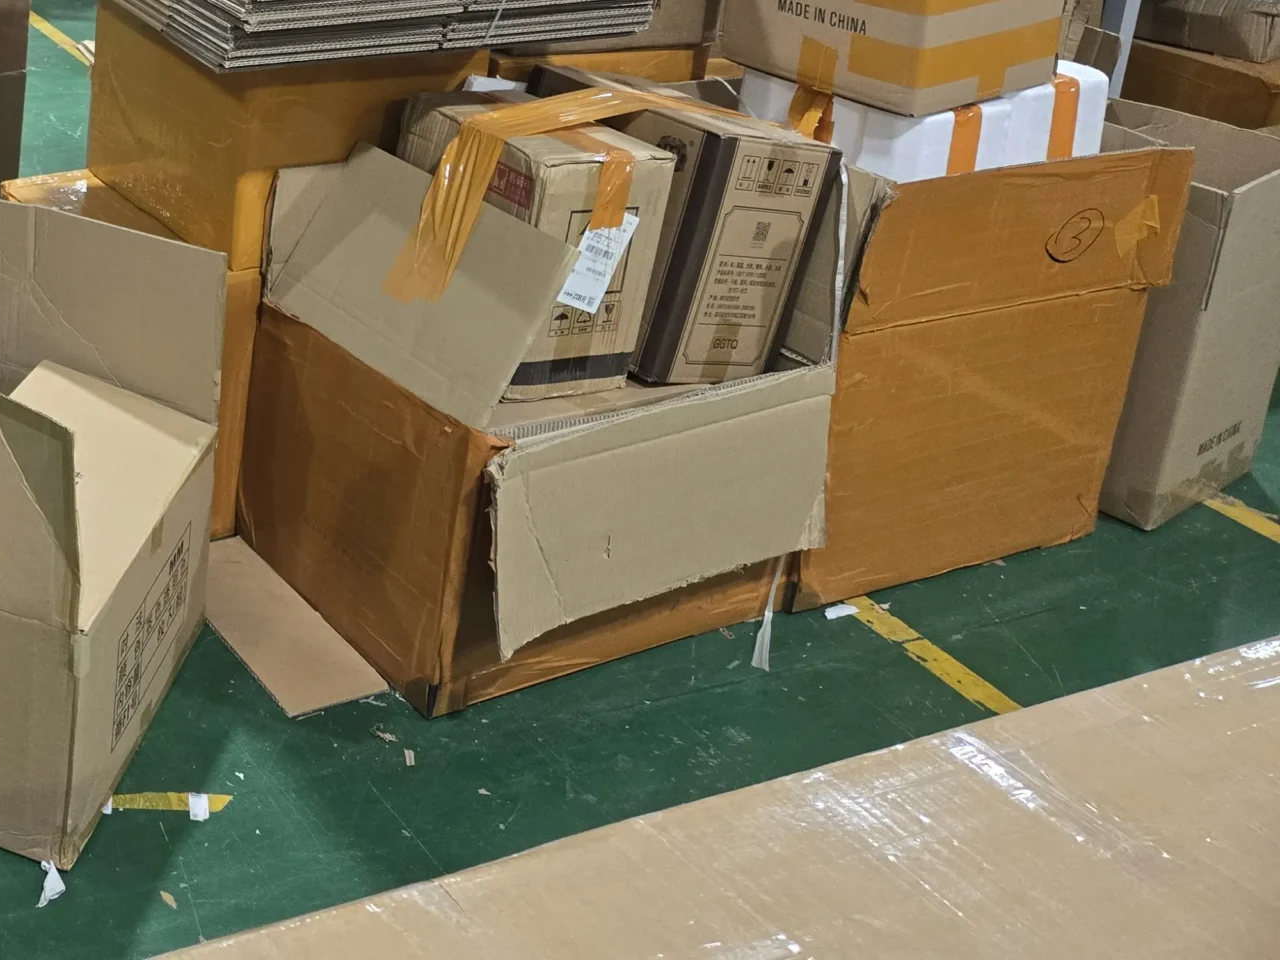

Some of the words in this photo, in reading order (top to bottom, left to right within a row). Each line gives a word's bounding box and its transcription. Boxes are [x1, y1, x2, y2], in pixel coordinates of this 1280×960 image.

[813, 7, 826, 24] IN
[829, 11, 867, 35] CHINA
[713, 338, 738, 350] GGTQ
[1197, 435, 1217, 457] MADE
[1222, 420, 1243, 442] CHINA
